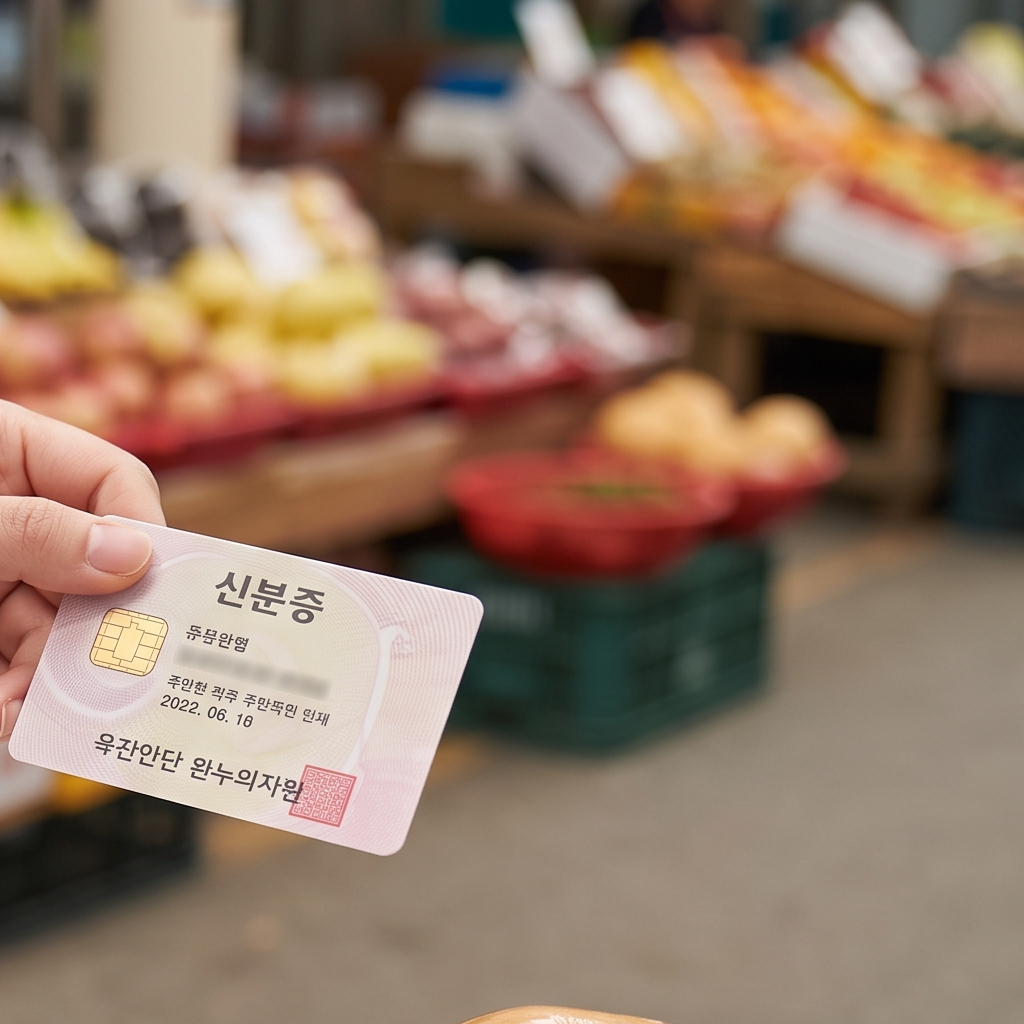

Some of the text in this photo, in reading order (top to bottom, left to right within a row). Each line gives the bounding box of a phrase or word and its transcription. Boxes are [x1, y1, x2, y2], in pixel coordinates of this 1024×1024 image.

[215, 570, 325, 625] 신분증
[160, 694, 201, 716] 2022.
[207, 706, 228, 723] 06.
